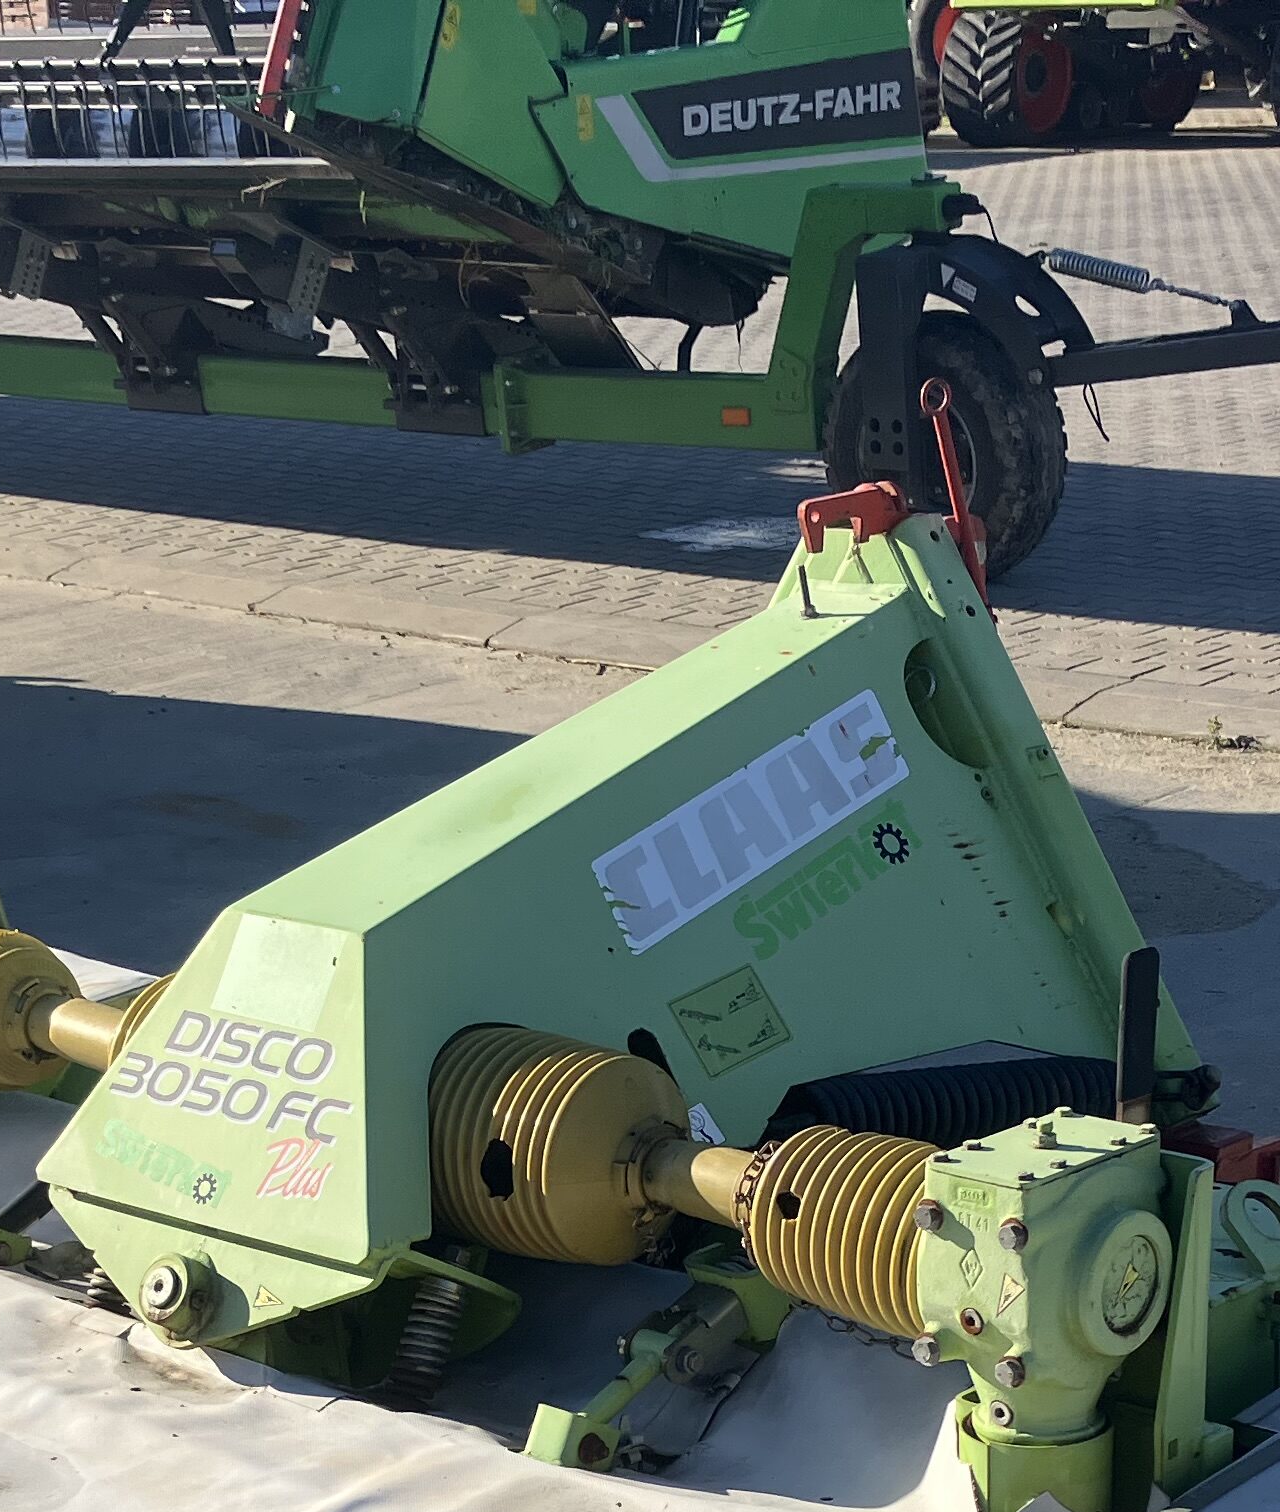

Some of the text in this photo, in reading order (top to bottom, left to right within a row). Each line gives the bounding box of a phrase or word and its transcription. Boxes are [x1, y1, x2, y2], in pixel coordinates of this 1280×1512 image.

[682, 80, 901, 137] DEUTZ-FAHR
[604, 701, 898, 942] CLAAS
[165, 1009, 335, 1084] DISCO
[109, 1051, 354, 1145] 3050 FC
[255, 1136, 334, 1199] Plus
